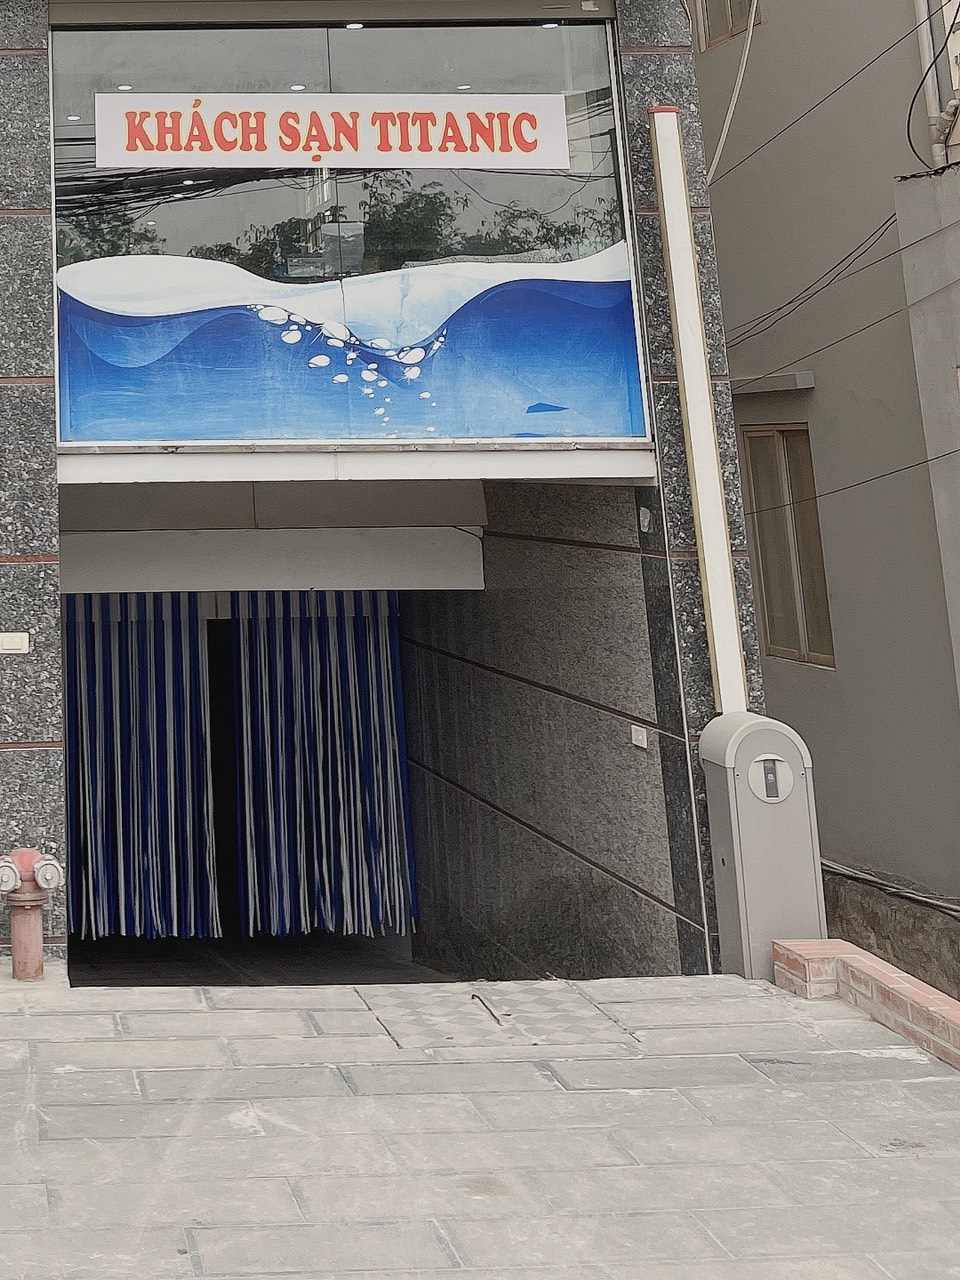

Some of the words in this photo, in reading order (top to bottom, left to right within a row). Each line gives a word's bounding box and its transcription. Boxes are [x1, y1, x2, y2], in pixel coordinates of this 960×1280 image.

[125, 99, 268, 151] KHÁCH
[278, 111, 360, 162] SẠN
[371, 111, 538, 153] TITANIC
